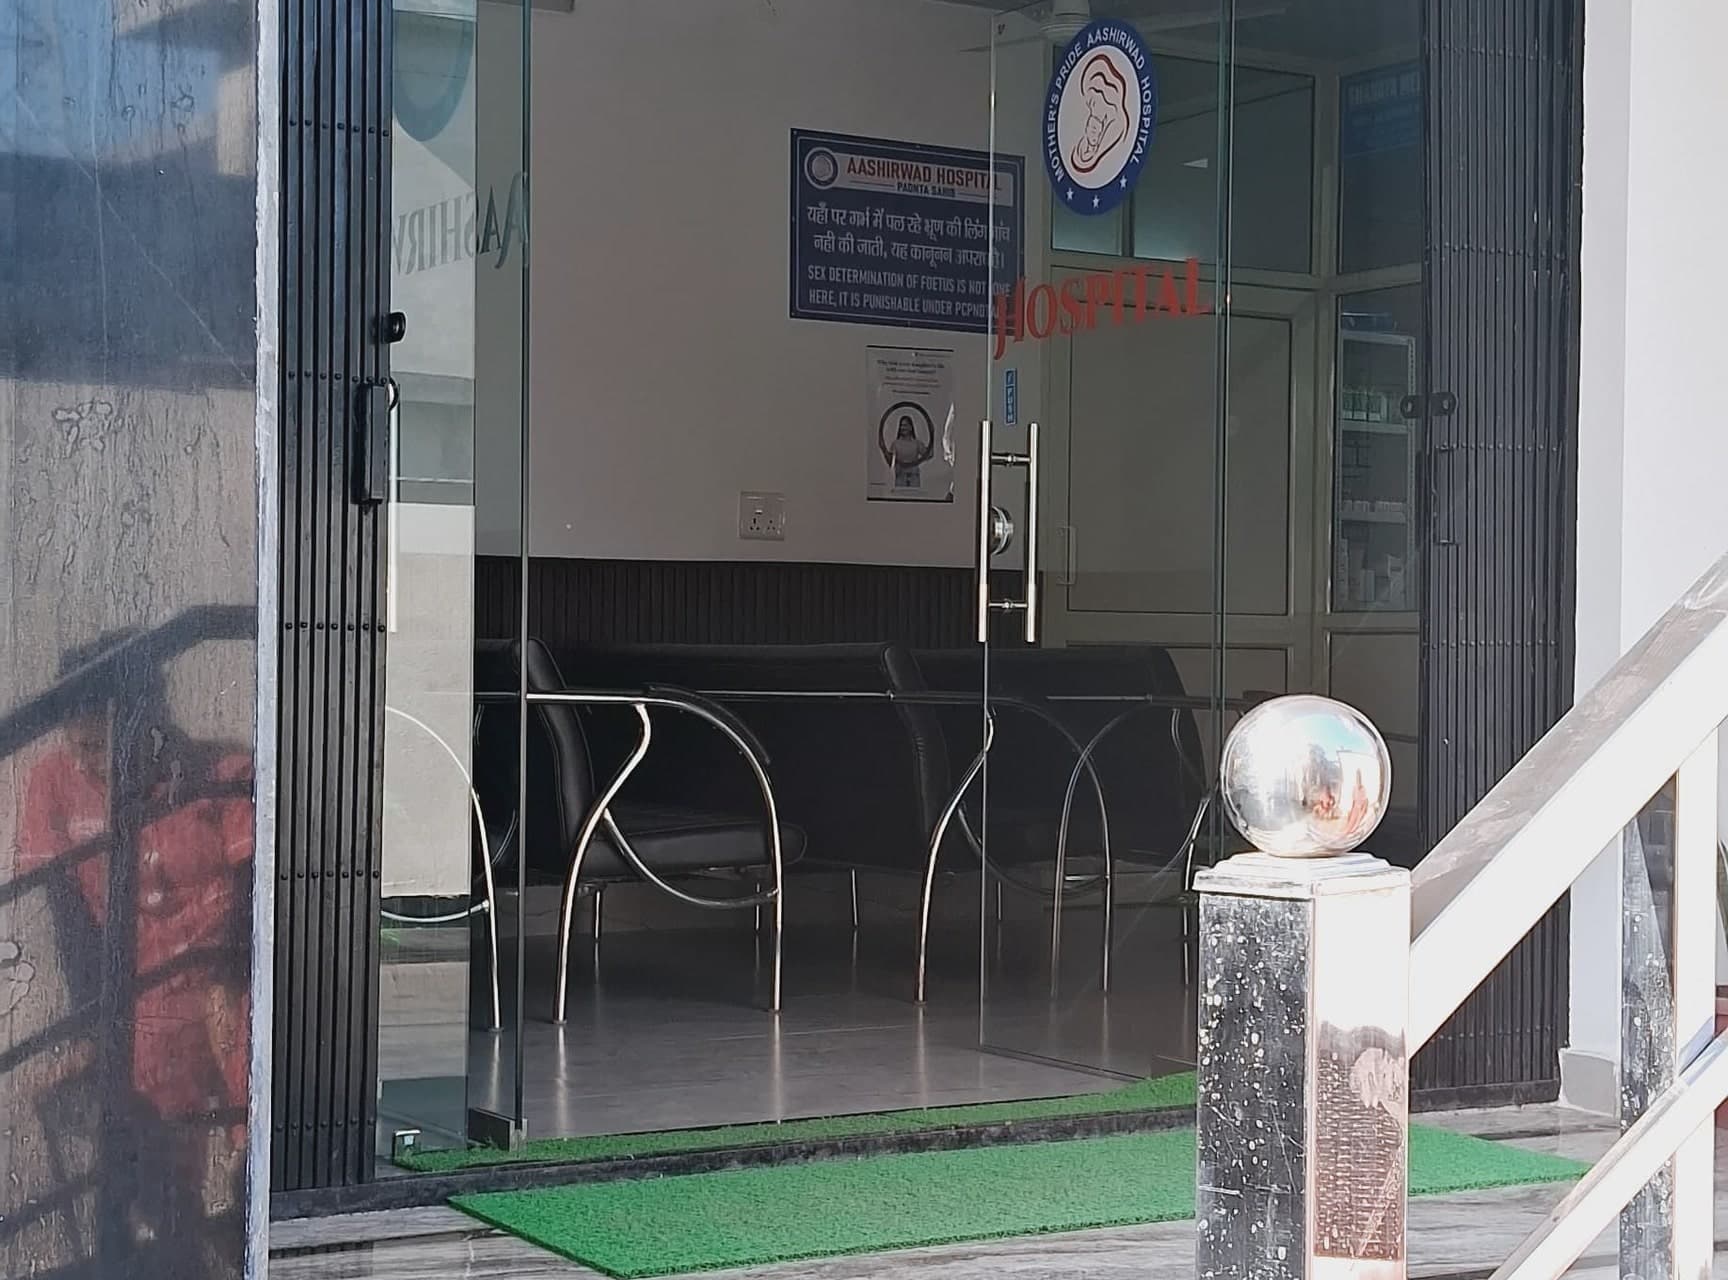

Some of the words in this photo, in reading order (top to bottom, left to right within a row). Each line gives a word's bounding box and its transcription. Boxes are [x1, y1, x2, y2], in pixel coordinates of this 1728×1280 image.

[1055, 41, 1083, 89] PRIDE
[1086, 26, 1145, 71] AASHIRWAD
[1047, 93, 1064, 183] MOTHER'S
[1129, 75, 1152, 164] HOSPITAL
[847, 156, 932, 183] AASHIRWAD
[937, 169, 1003, 191] HOSPITAL
[831, 208, 847, 226] पर
[849, 206, 870, 229] गर्भ
[886, 214, 905, 233] पल
[906, 211, 923, 234] रहे
[945, 215, 962, 238] की
[964, 217, 988, 240] लिंग
[837, 231, 855, 255] की
[890, 241, 909, 261] यह
[808, 264, 826, 281] SEX
[828, 267, 903, 287] DETERMINATION
[906, 273, 919, 289] OF
[920, 275, 955, 293] FOETUS
[957, 279, 967, 294] IS
[969, 280, 987, 297] NOT
[988, 281, 1011, 297] ONE
[839, 291, 849, 307] IT
[850, 292, 860, 307] IS
[863, 293, 920, 313] PUNISHABLE
[922, 297, 952, 316] UNDER
[993, 256, 1212, 360] HOSPITAL
